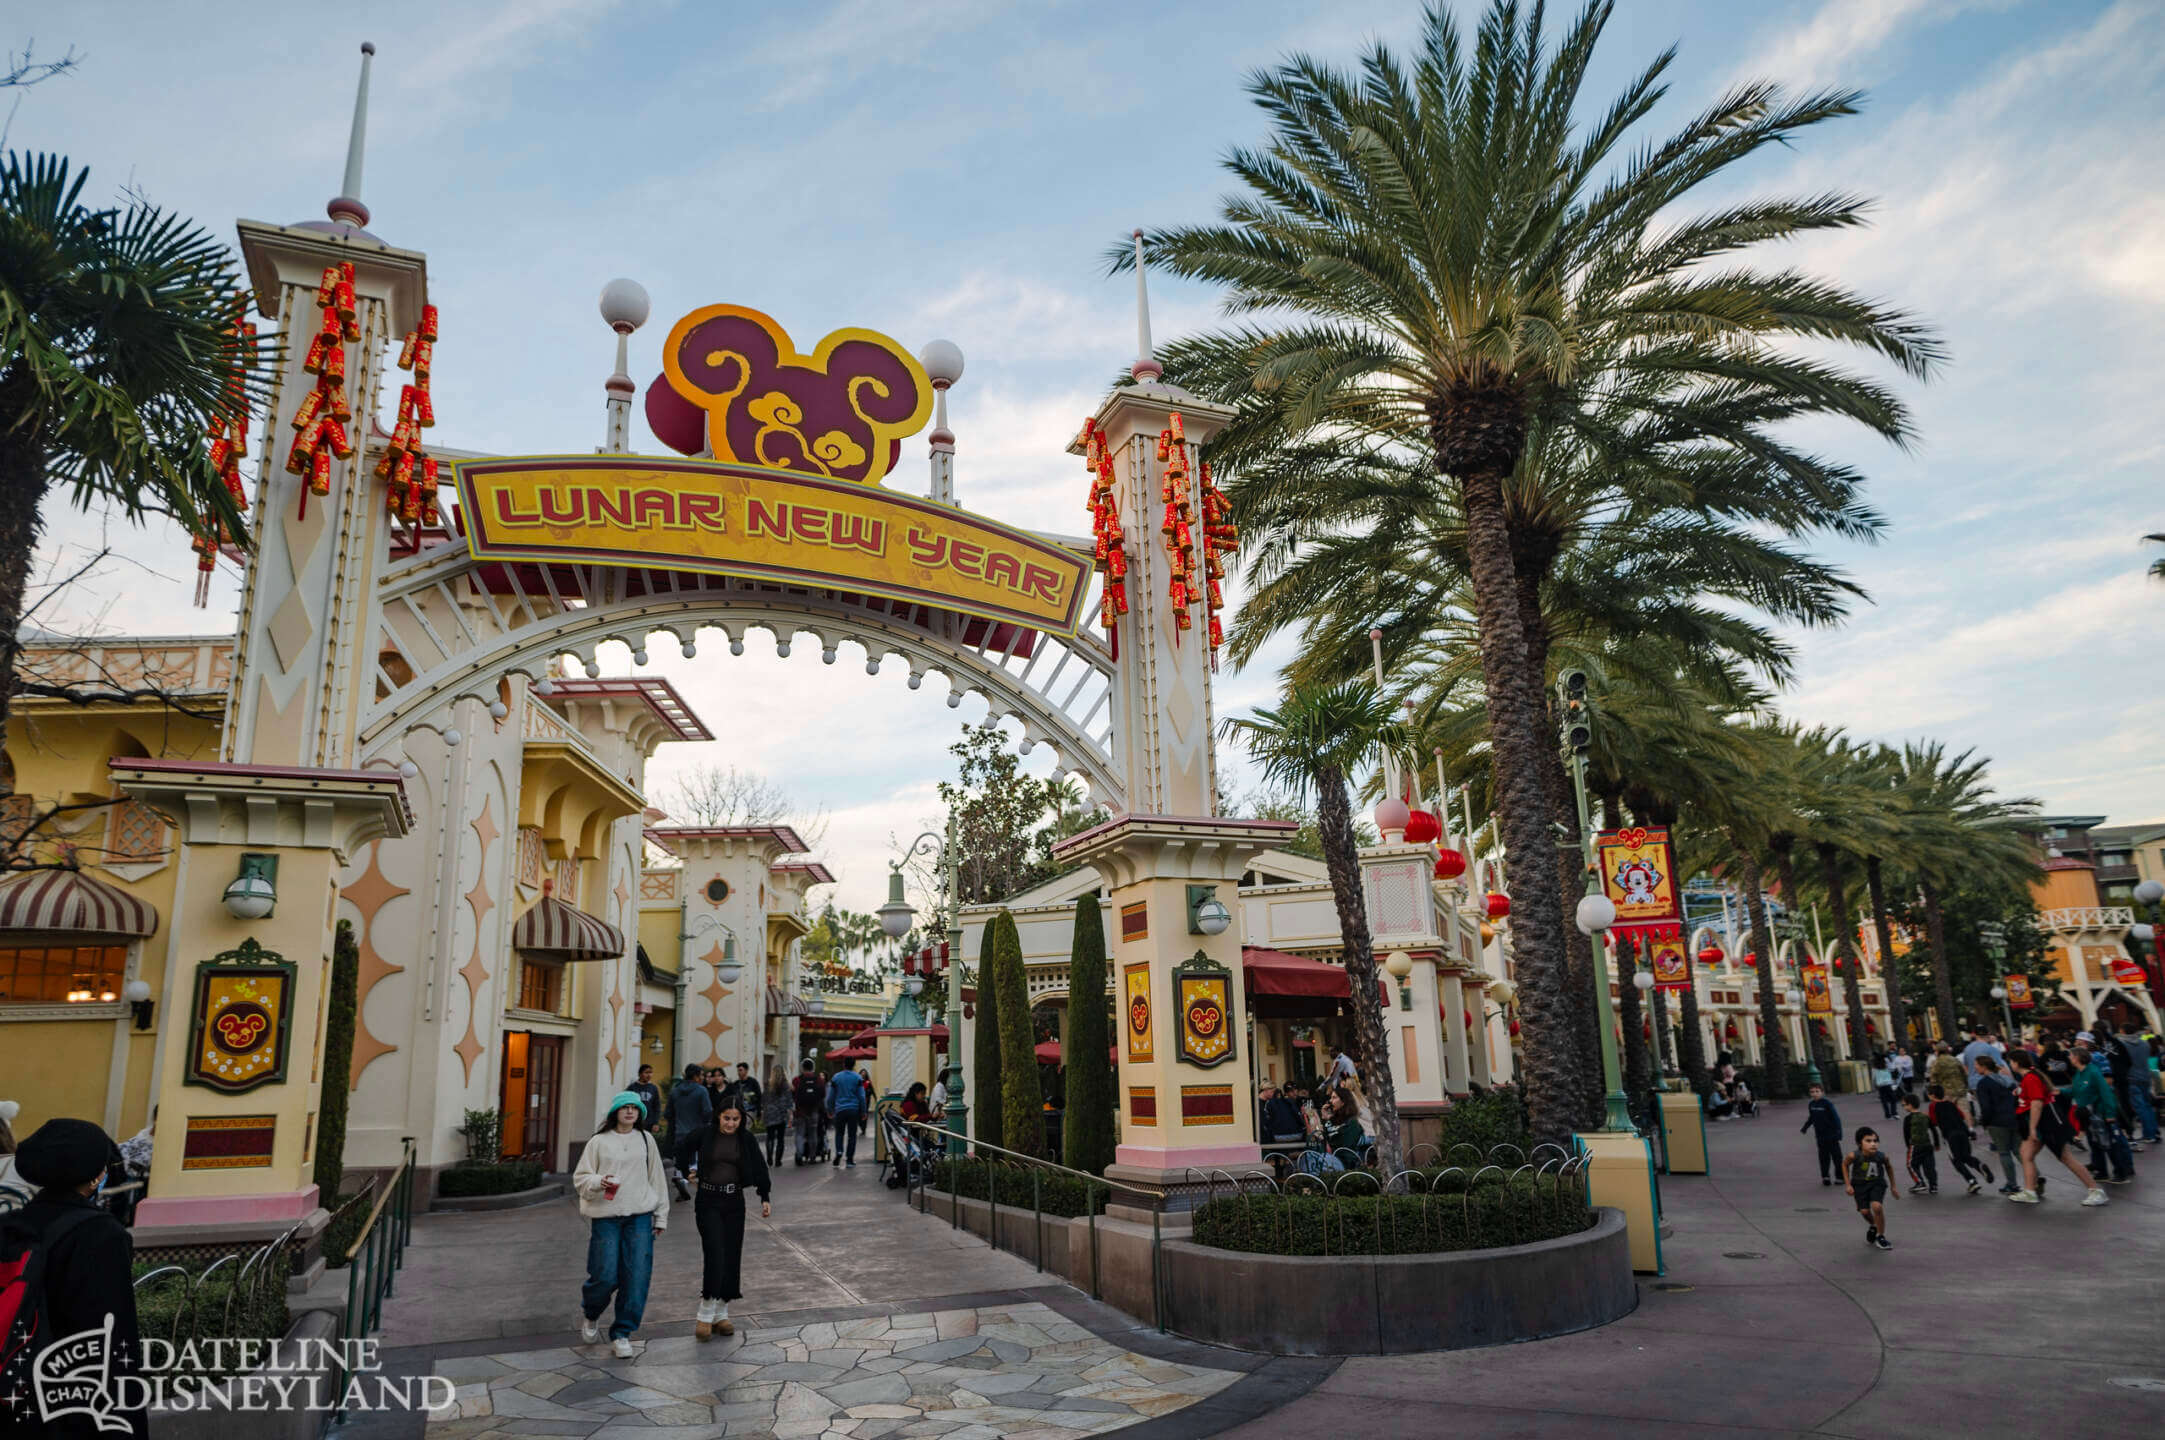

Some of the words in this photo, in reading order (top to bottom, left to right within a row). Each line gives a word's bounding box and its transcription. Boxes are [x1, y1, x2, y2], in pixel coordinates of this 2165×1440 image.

[491, 485, 726, 532] LUNAR
[744, 496, 886, 557] NEW
[906, 525, 1065, 606] YEAR
